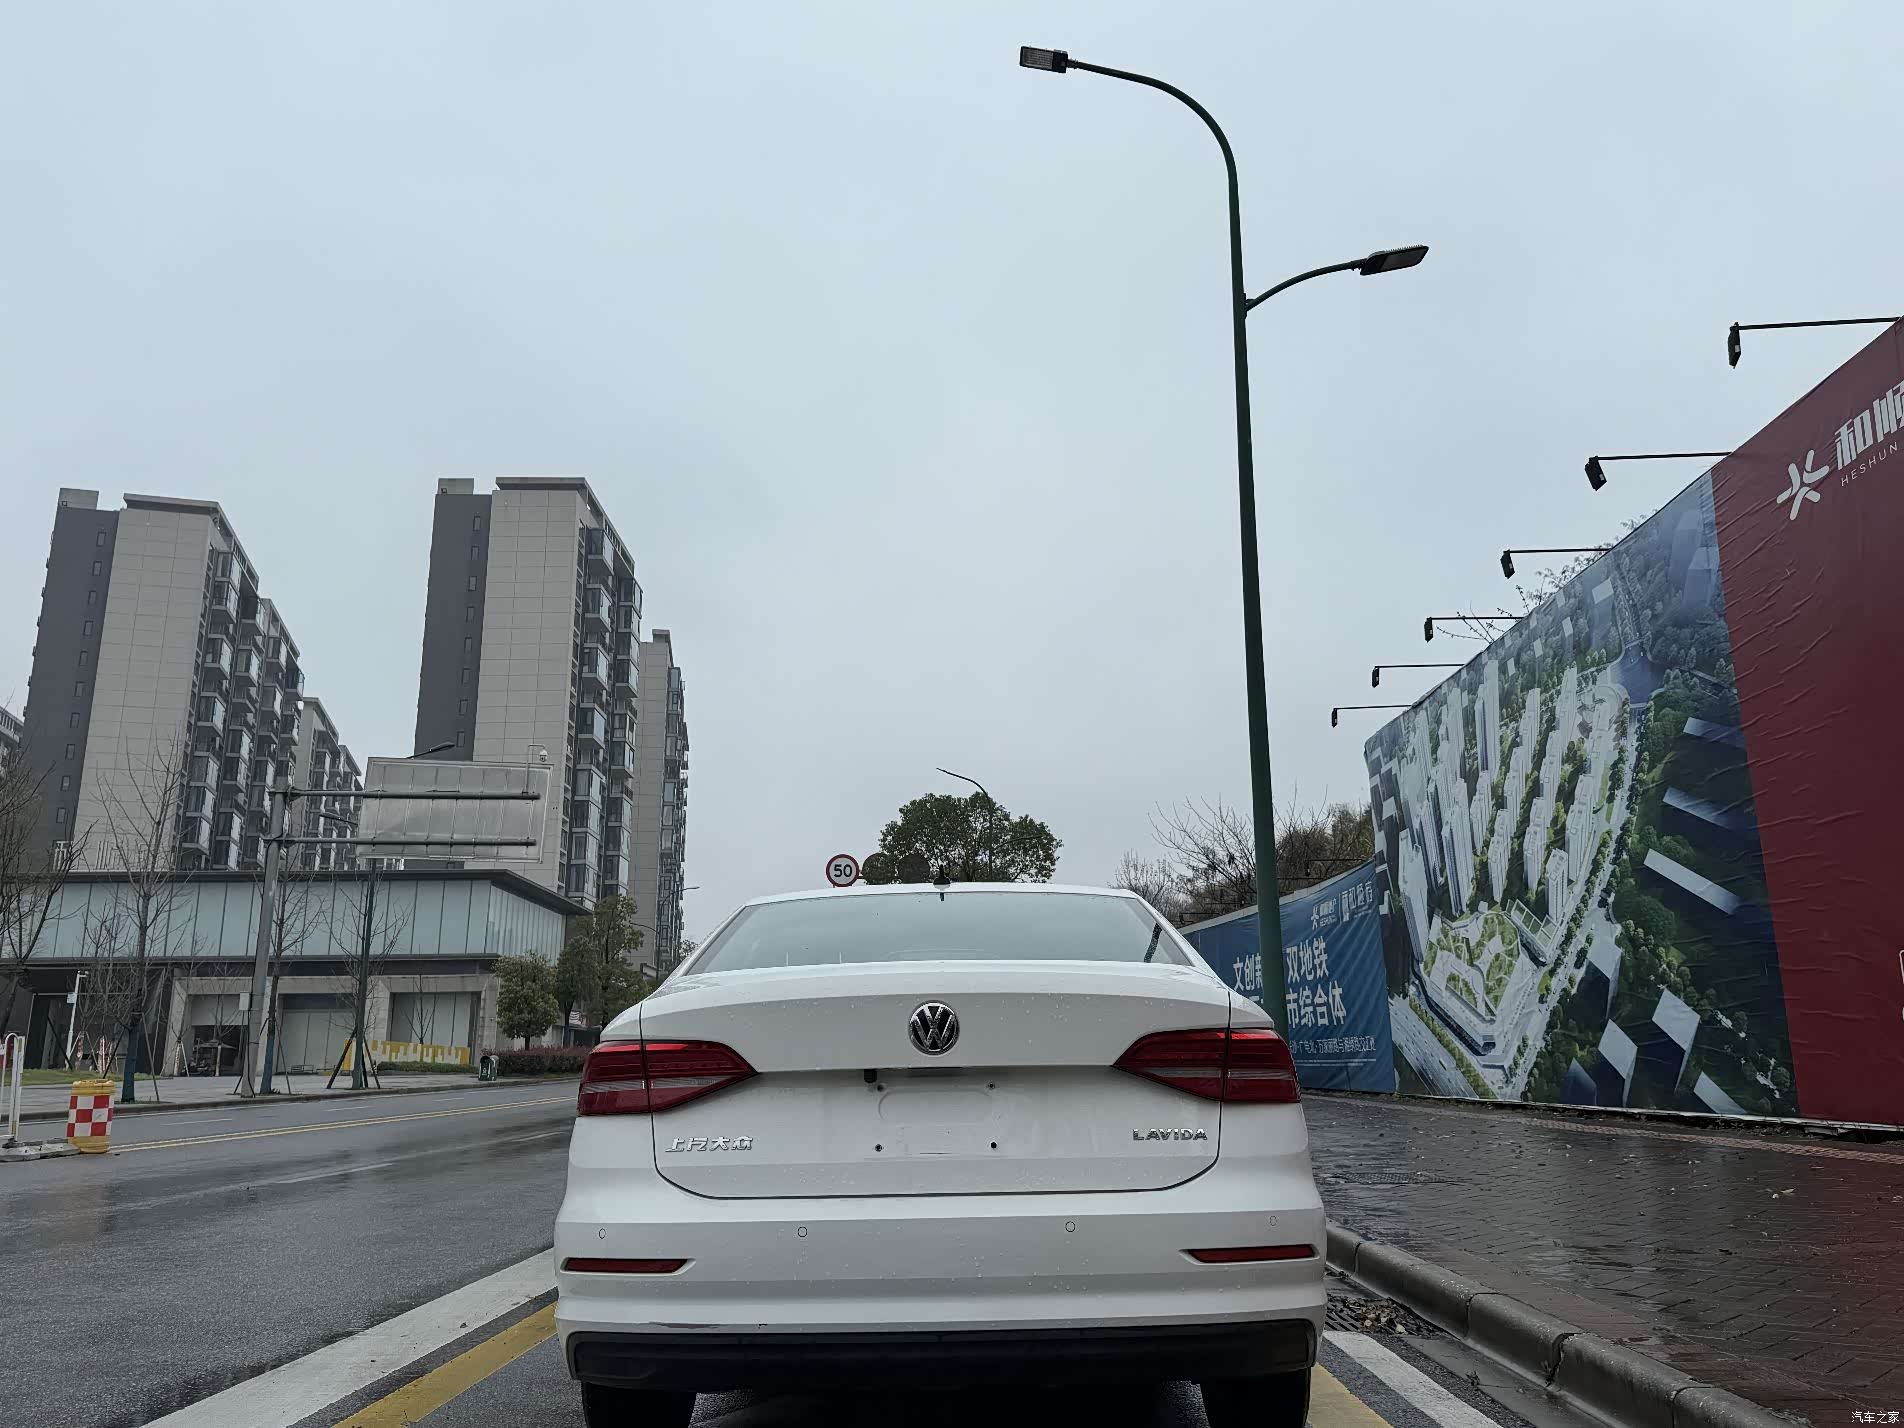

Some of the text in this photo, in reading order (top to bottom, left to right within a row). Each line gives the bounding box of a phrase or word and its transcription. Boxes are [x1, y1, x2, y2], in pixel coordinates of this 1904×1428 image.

[1840, 441, 1898, 487] HESHUN
[833, 863, 853, 878] 50
[1285, 935, 1329, 984] 双地铁
[1285, 980, 1347, 1029] 市综合体
[665, 1136, 753, 1152] 上汽大众
[1132, 1128, 1208, 1141] LAVIDA
